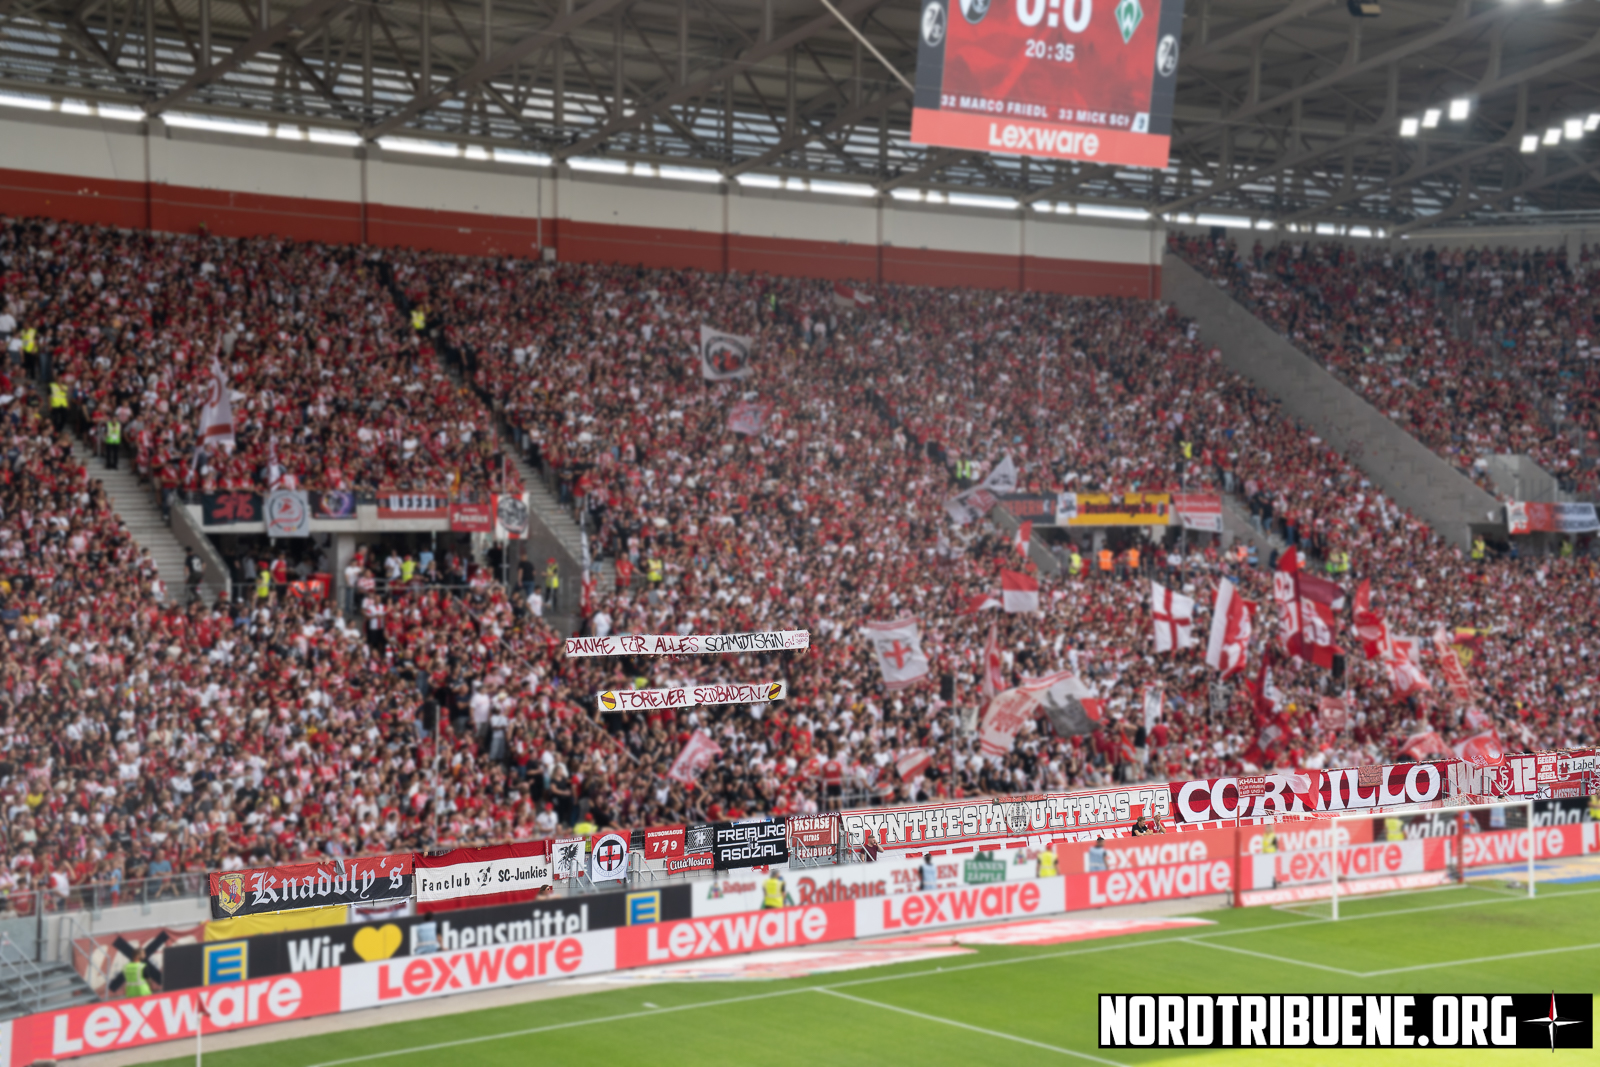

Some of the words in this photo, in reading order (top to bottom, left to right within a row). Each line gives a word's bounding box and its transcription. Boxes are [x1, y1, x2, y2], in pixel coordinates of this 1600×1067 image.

[1025, 39, 1075, 62] 20:35
[941, 94, 957, 107] 32
[960, 96, 1004, 113] MARCO
[1007, 102, 1048, 118] FRIEDL
[1058, 108, 1073, 121] 33
[1076, 109, 1106, 125] MICK
[988, 123, 1100, 156] Lexware
[566, 637, 615, 654] DANKE
[620, 635, 648, 653] FÜR
[655, 636, 699, 653] ALLES
[619, 689, 687, 708] FOREVER
[693, 684, 769, 704] SÜDBADEN!
[1573, 759, 1594, 771] Label
[847, 804, 1007, 846] SYNTHESIA
[1030, 792, 1130, 830] ULTRAS
[1139, 788, 1170, 818] 79
[721, 844, 783, 861] ASOZIAL
[1275, 843, 1402, 886] Lexware
[422, 873, 471, 892] Fanclub
[498, 866, 548, 883] SC-Junkies
[891, 864, 959, 884] TANEN
[1090, 861, 1231, 904] Lexware
[797, 877, 887, 905] Rothaus
[883, 882, 1041, 930] Lexware
[288, 935, 346, 973] Wir
[410, 904, 589, 955] Lbensmittel
[648, 906, 827, 961] Lexware
[378, 937, 583, 1000] Lexware
[52, 978, 302, 1055] Lexware
